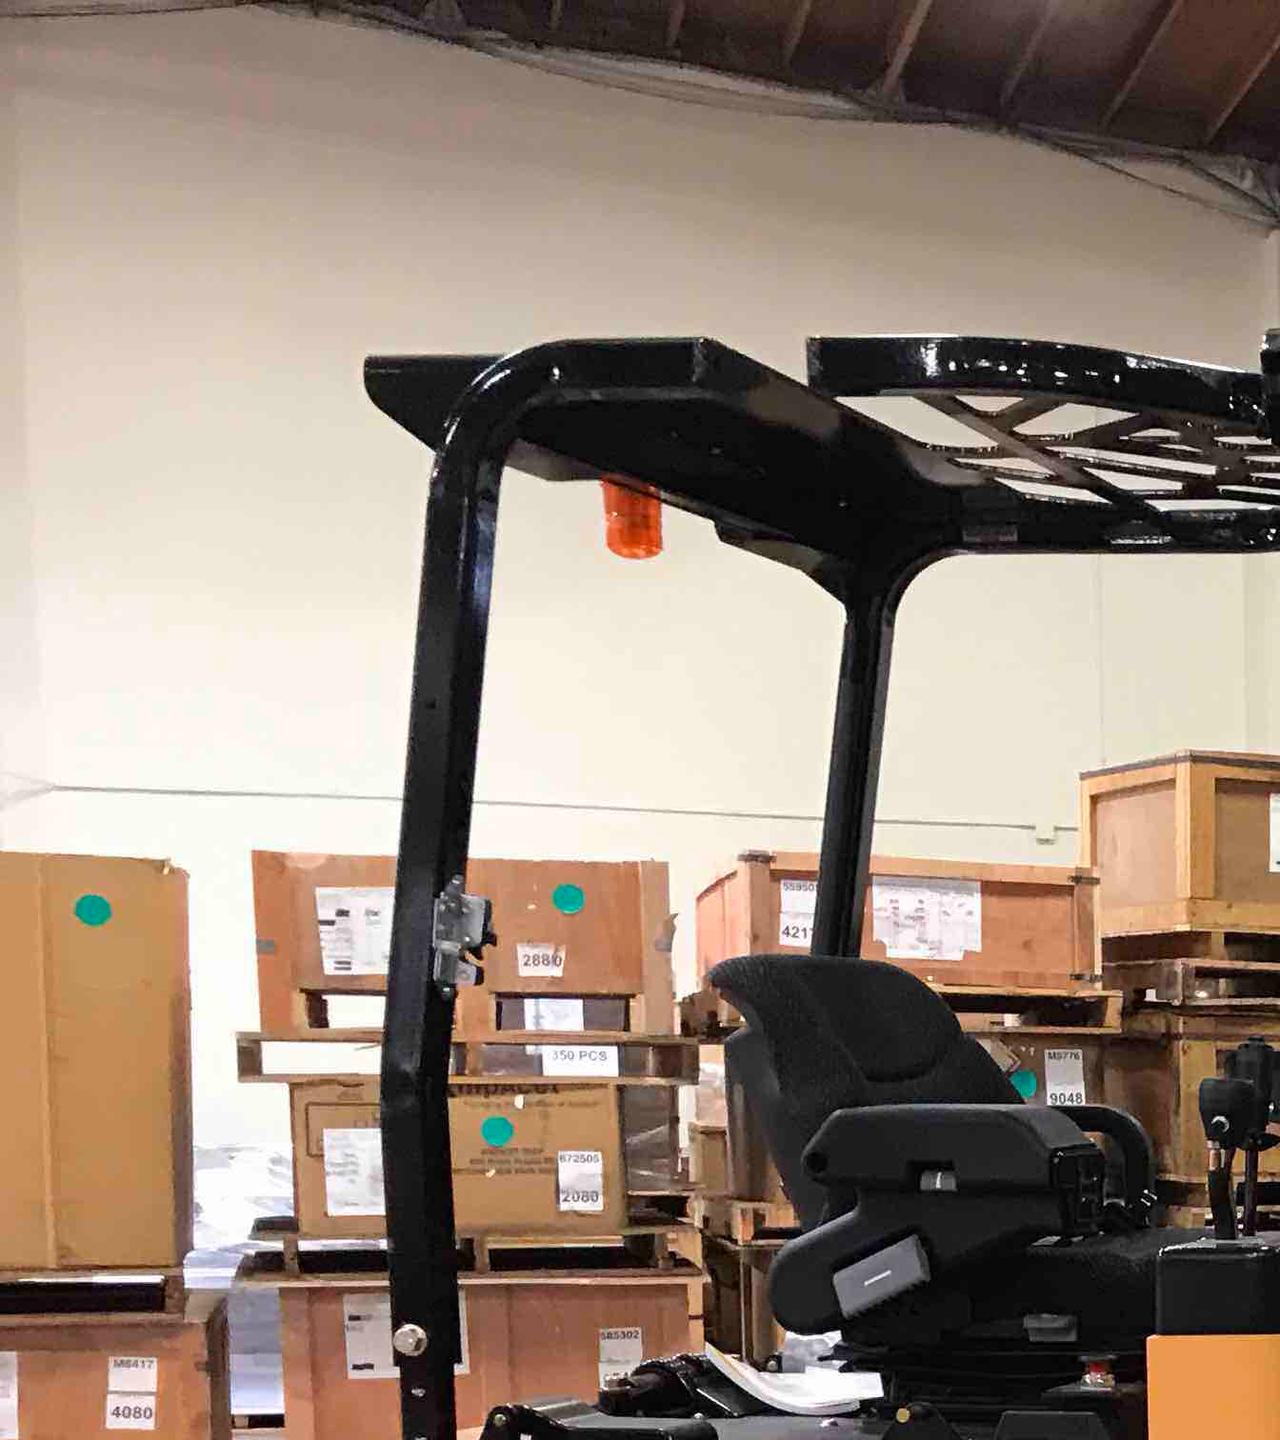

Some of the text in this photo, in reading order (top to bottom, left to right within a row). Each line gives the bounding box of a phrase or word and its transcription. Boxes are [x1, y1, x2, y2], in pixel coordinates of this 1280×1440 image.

[579, 1051, 608, 1061] PCS
[1049, 1092, 1083, 1105] 9048
[561, 1189, 599, 1203] 2080
[111, 1406, 154, 1420] 4080
